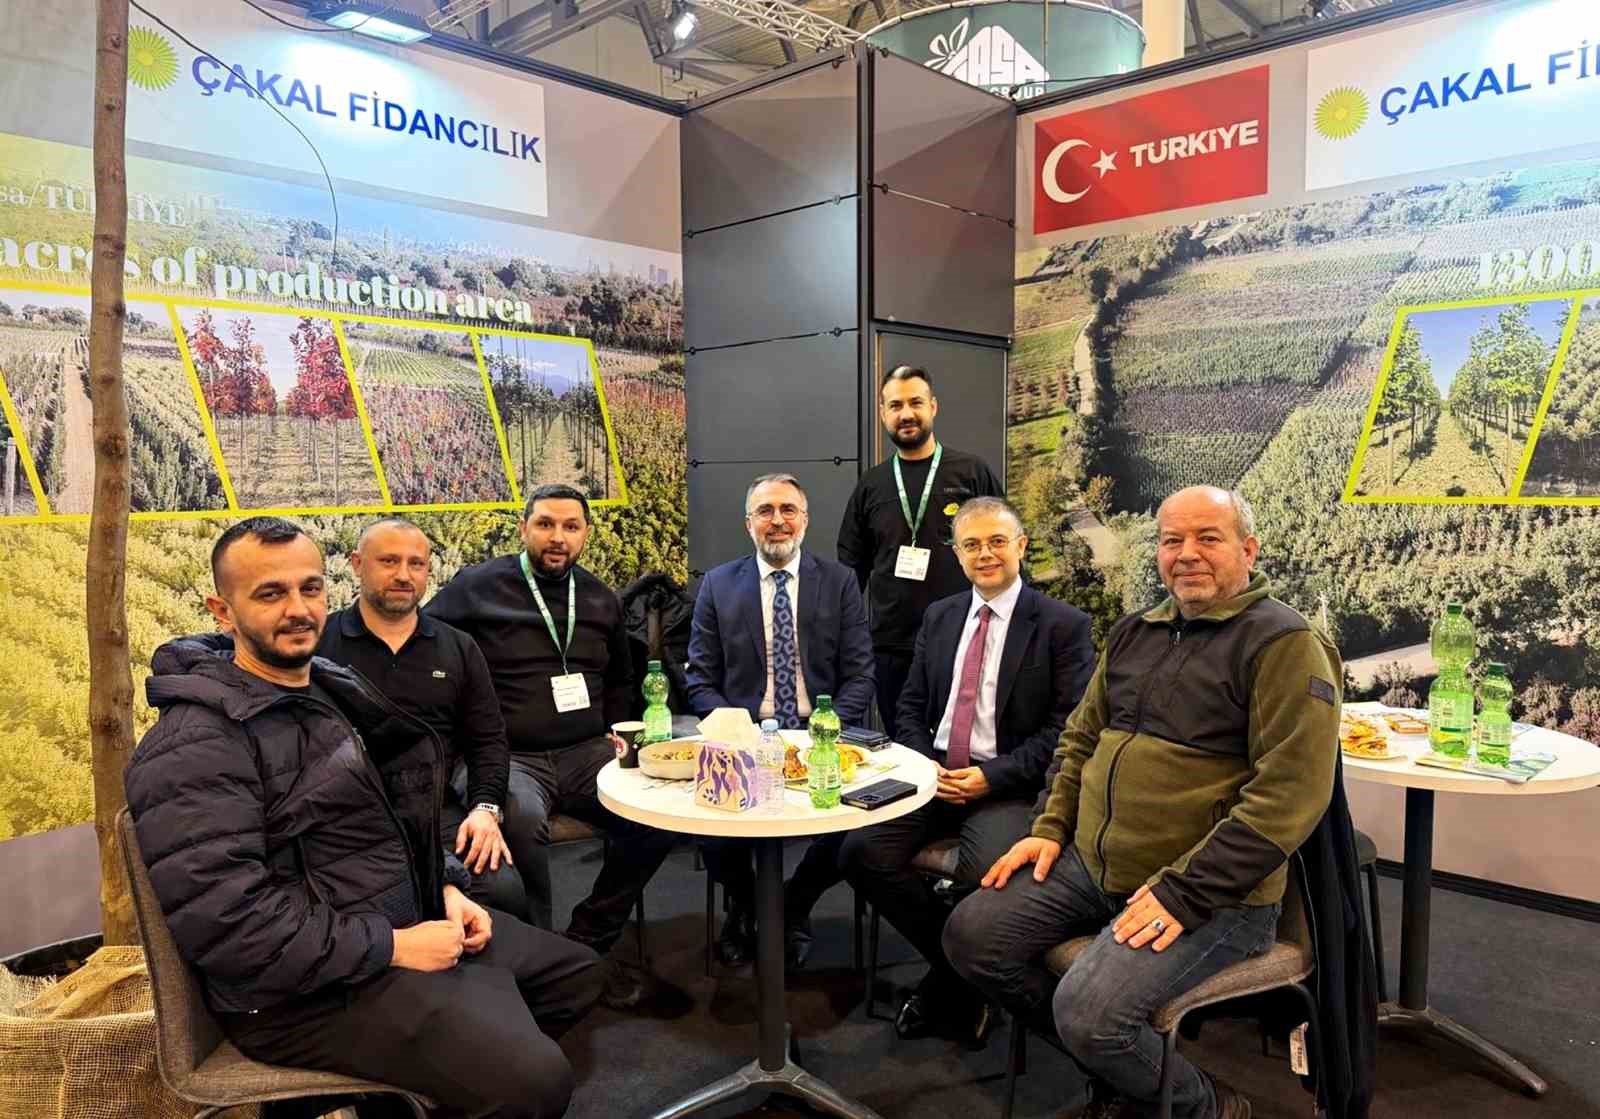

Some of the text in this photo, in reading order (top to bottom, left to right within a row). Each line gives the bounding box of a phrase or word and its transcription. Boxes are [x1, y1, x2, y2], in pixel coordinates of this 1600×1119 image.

[191, 54, 542, 163] ÇAKAL FİDANCILIK
[1380, 40, 1600, 126] ÇAKAL Fİ
[1129, 119, 1259, 168] TÜRKİYE
[0, 237, 534, 325] acrs of production area
